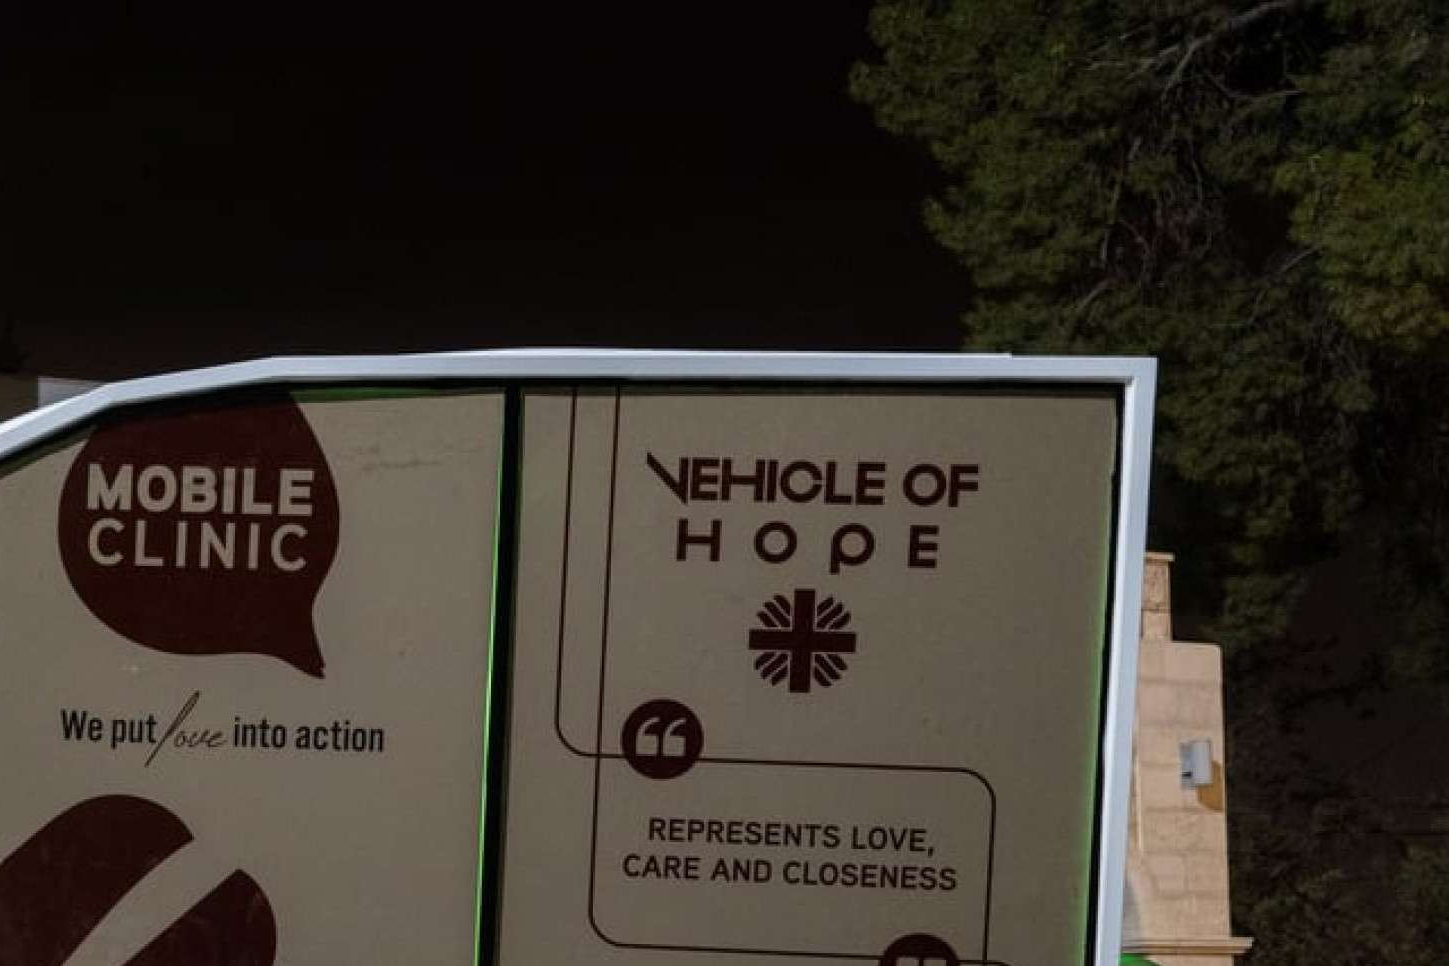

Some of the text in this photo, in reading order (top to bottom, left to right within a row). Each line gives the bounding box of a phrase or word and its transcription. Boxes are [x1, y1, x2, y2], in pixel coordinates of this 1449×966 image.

[86, 463, 315, 518] MOBILE
[647, 451, 979, 508] VEHICLE OF
[88, 517, 309, 572] CLINIC
[60, 690, 386, 768] We put love into action
[648, 817, 935, 857] REPRESENTS LOVE,
[622, 853, 958, 892] CARE AND CLOSENESS
